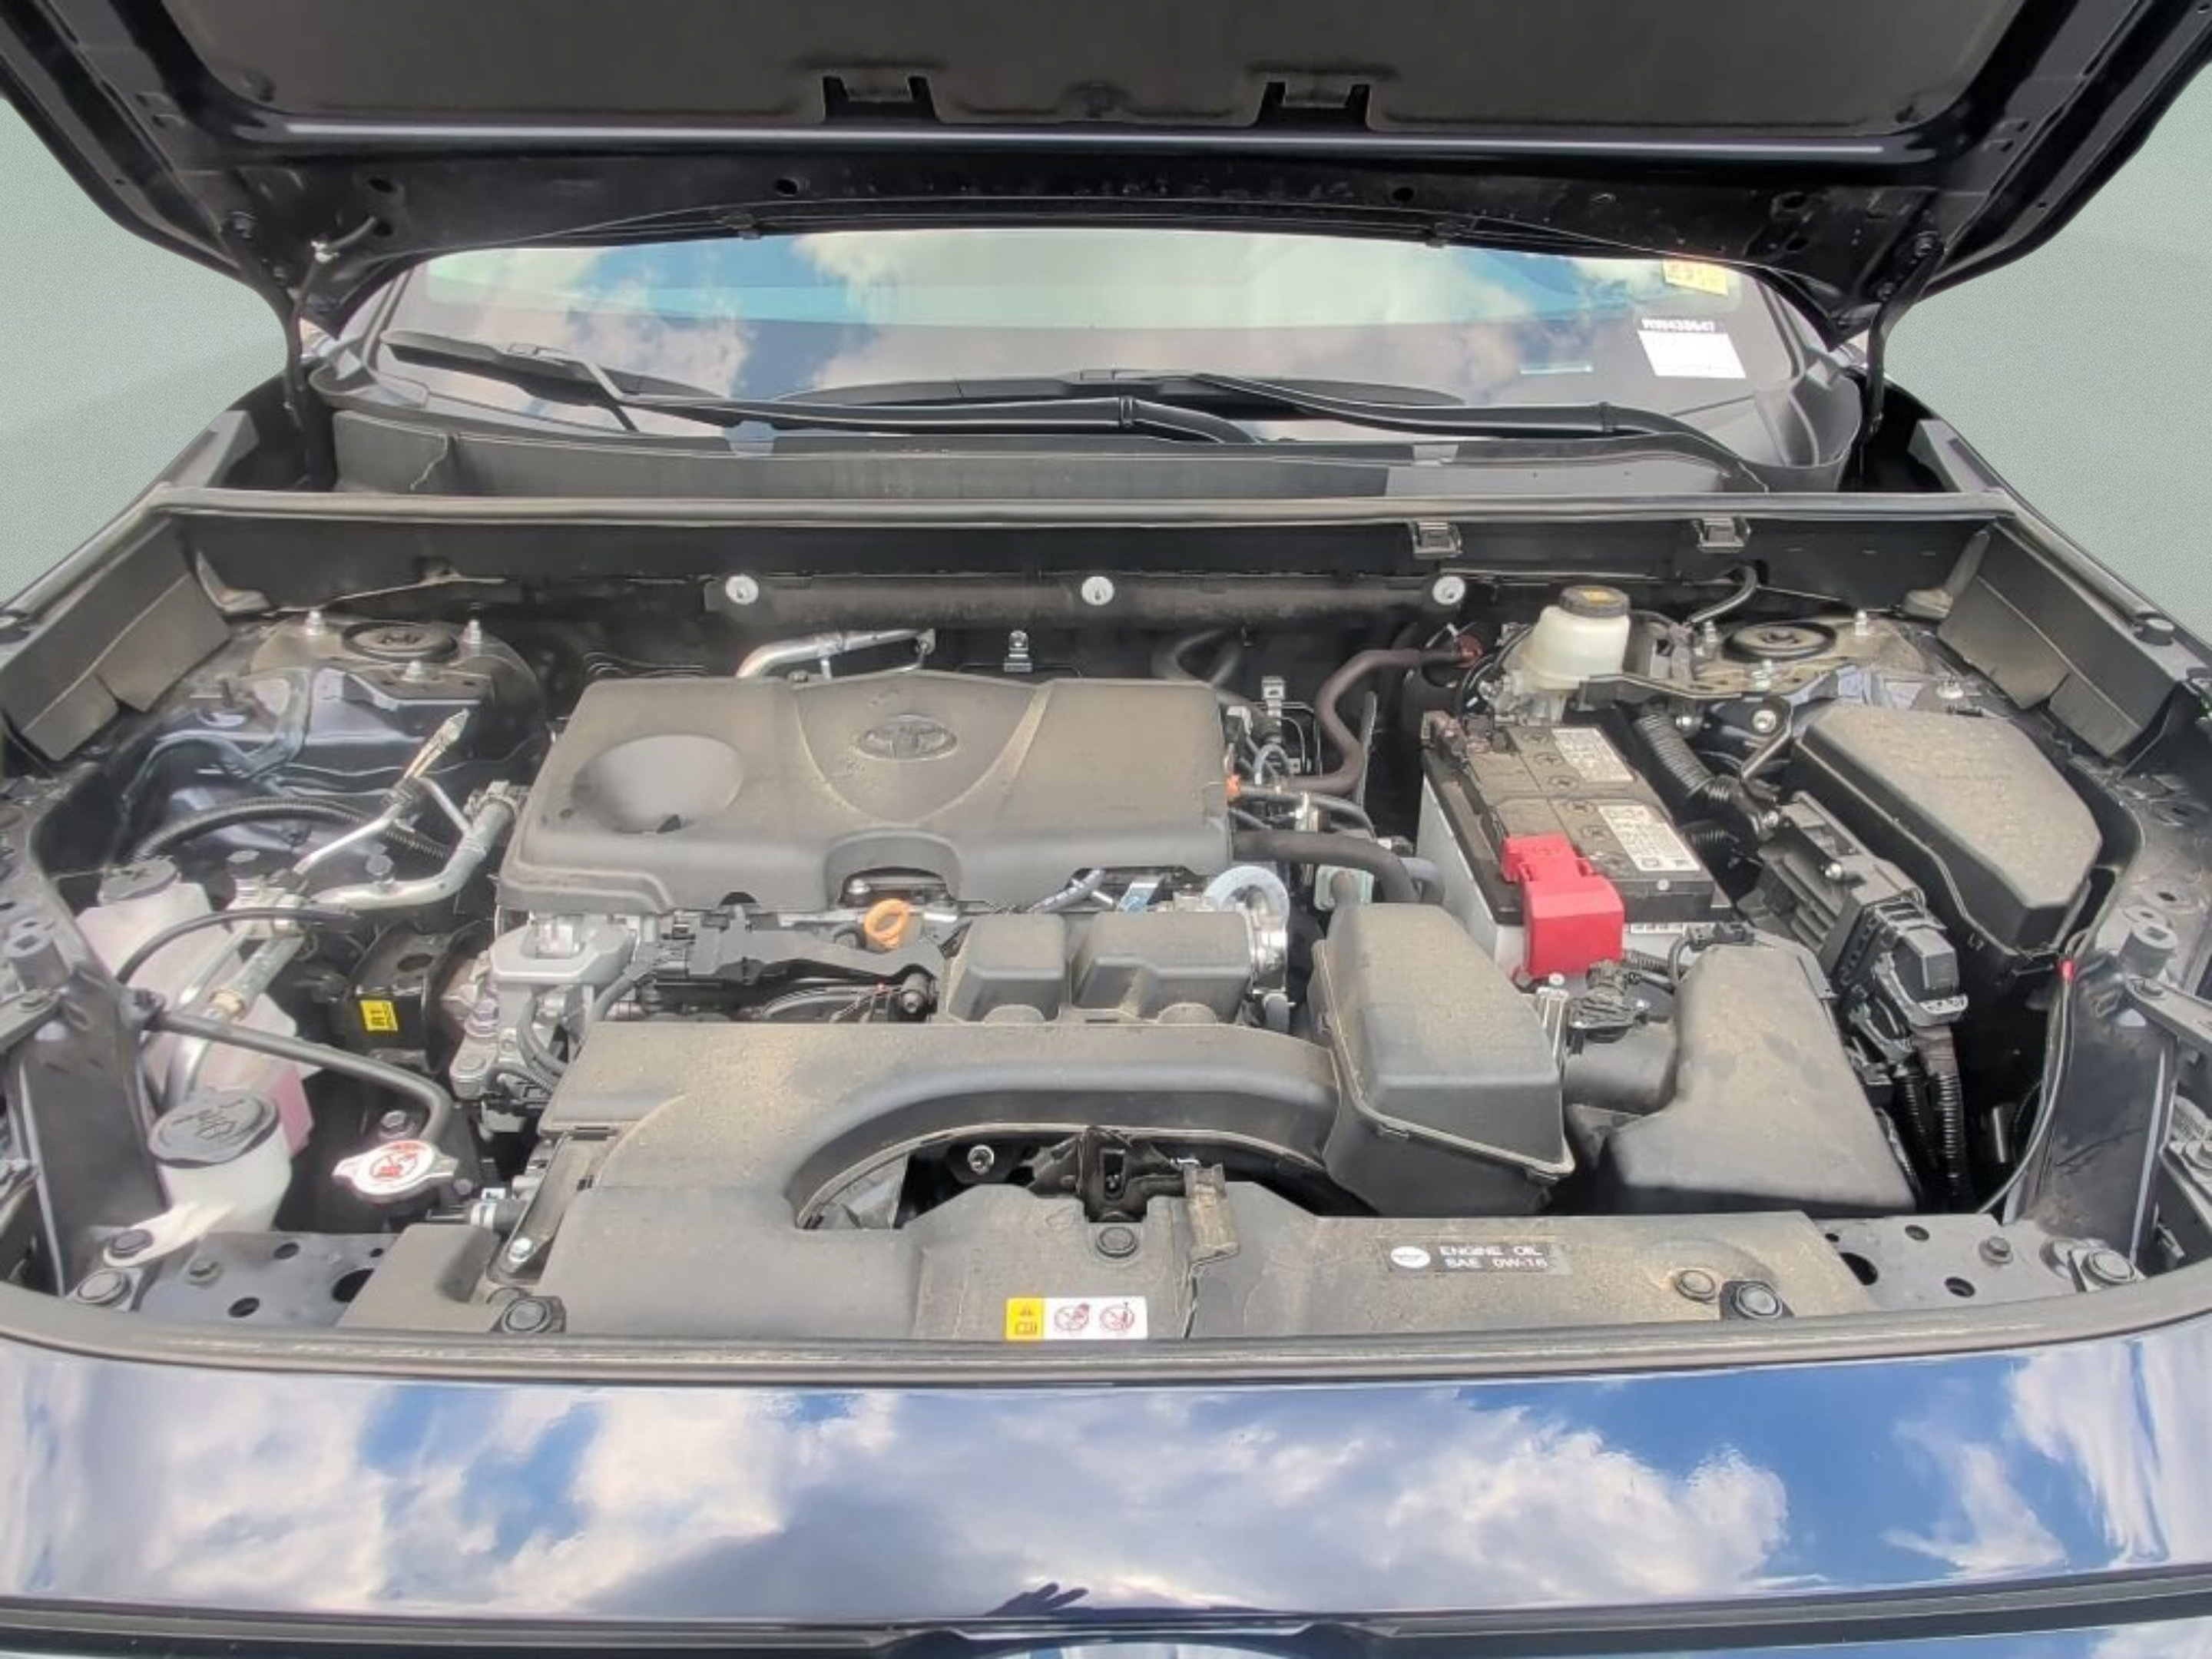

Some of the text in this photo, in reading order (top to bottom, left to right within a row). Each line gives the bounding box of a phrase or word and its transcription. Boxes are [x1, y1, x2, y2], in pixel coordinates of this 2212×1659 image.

[1439, 1245, 1543, 1256] ENGINE OIL
[1444, 1258, 1482, 1269] SAE
